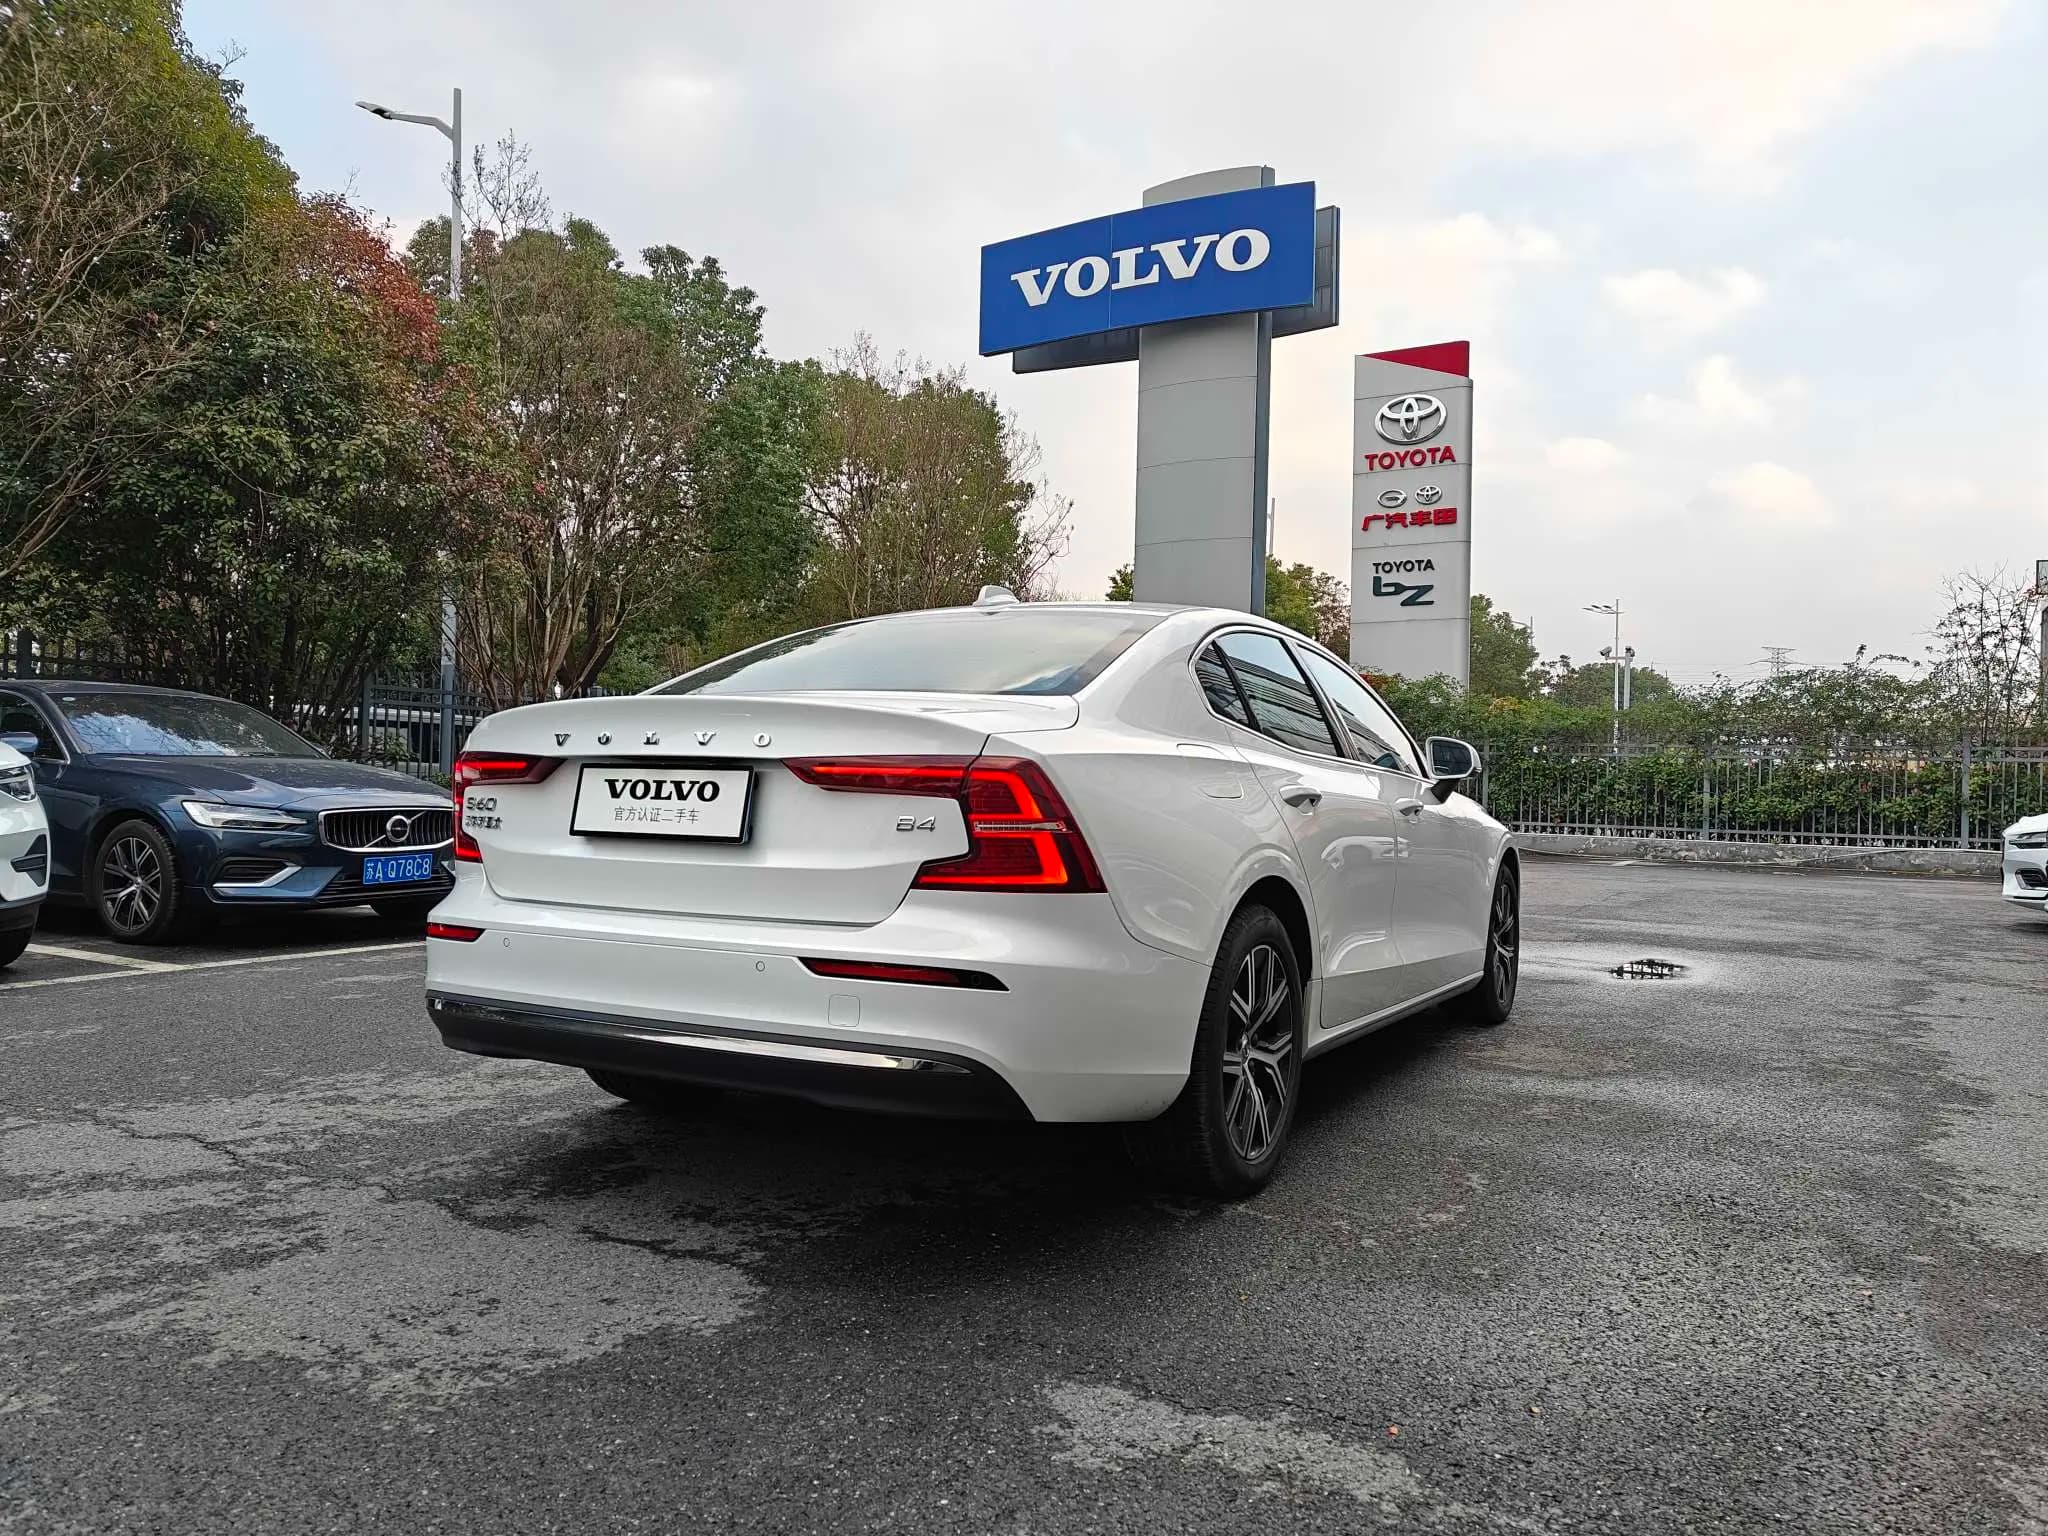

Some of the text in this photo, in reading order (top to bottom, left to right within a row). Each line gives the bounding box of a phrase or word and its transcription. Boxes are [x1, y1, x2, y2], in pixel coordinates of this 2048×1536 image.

[1010, 228, 1271, 307] VOLVO
[1364, 445, 1456, 471] TOYOTA
[1372, 558, 1435, 574] TOYOTA
[554, 731, 772, 748] VOLVO
[604, 778, 721, 803] VOLVO
[466, 796, 498, 811] S60
[613, 806, 700, 824] 官方认证二手车
[896, 815, 936, 832] B4
